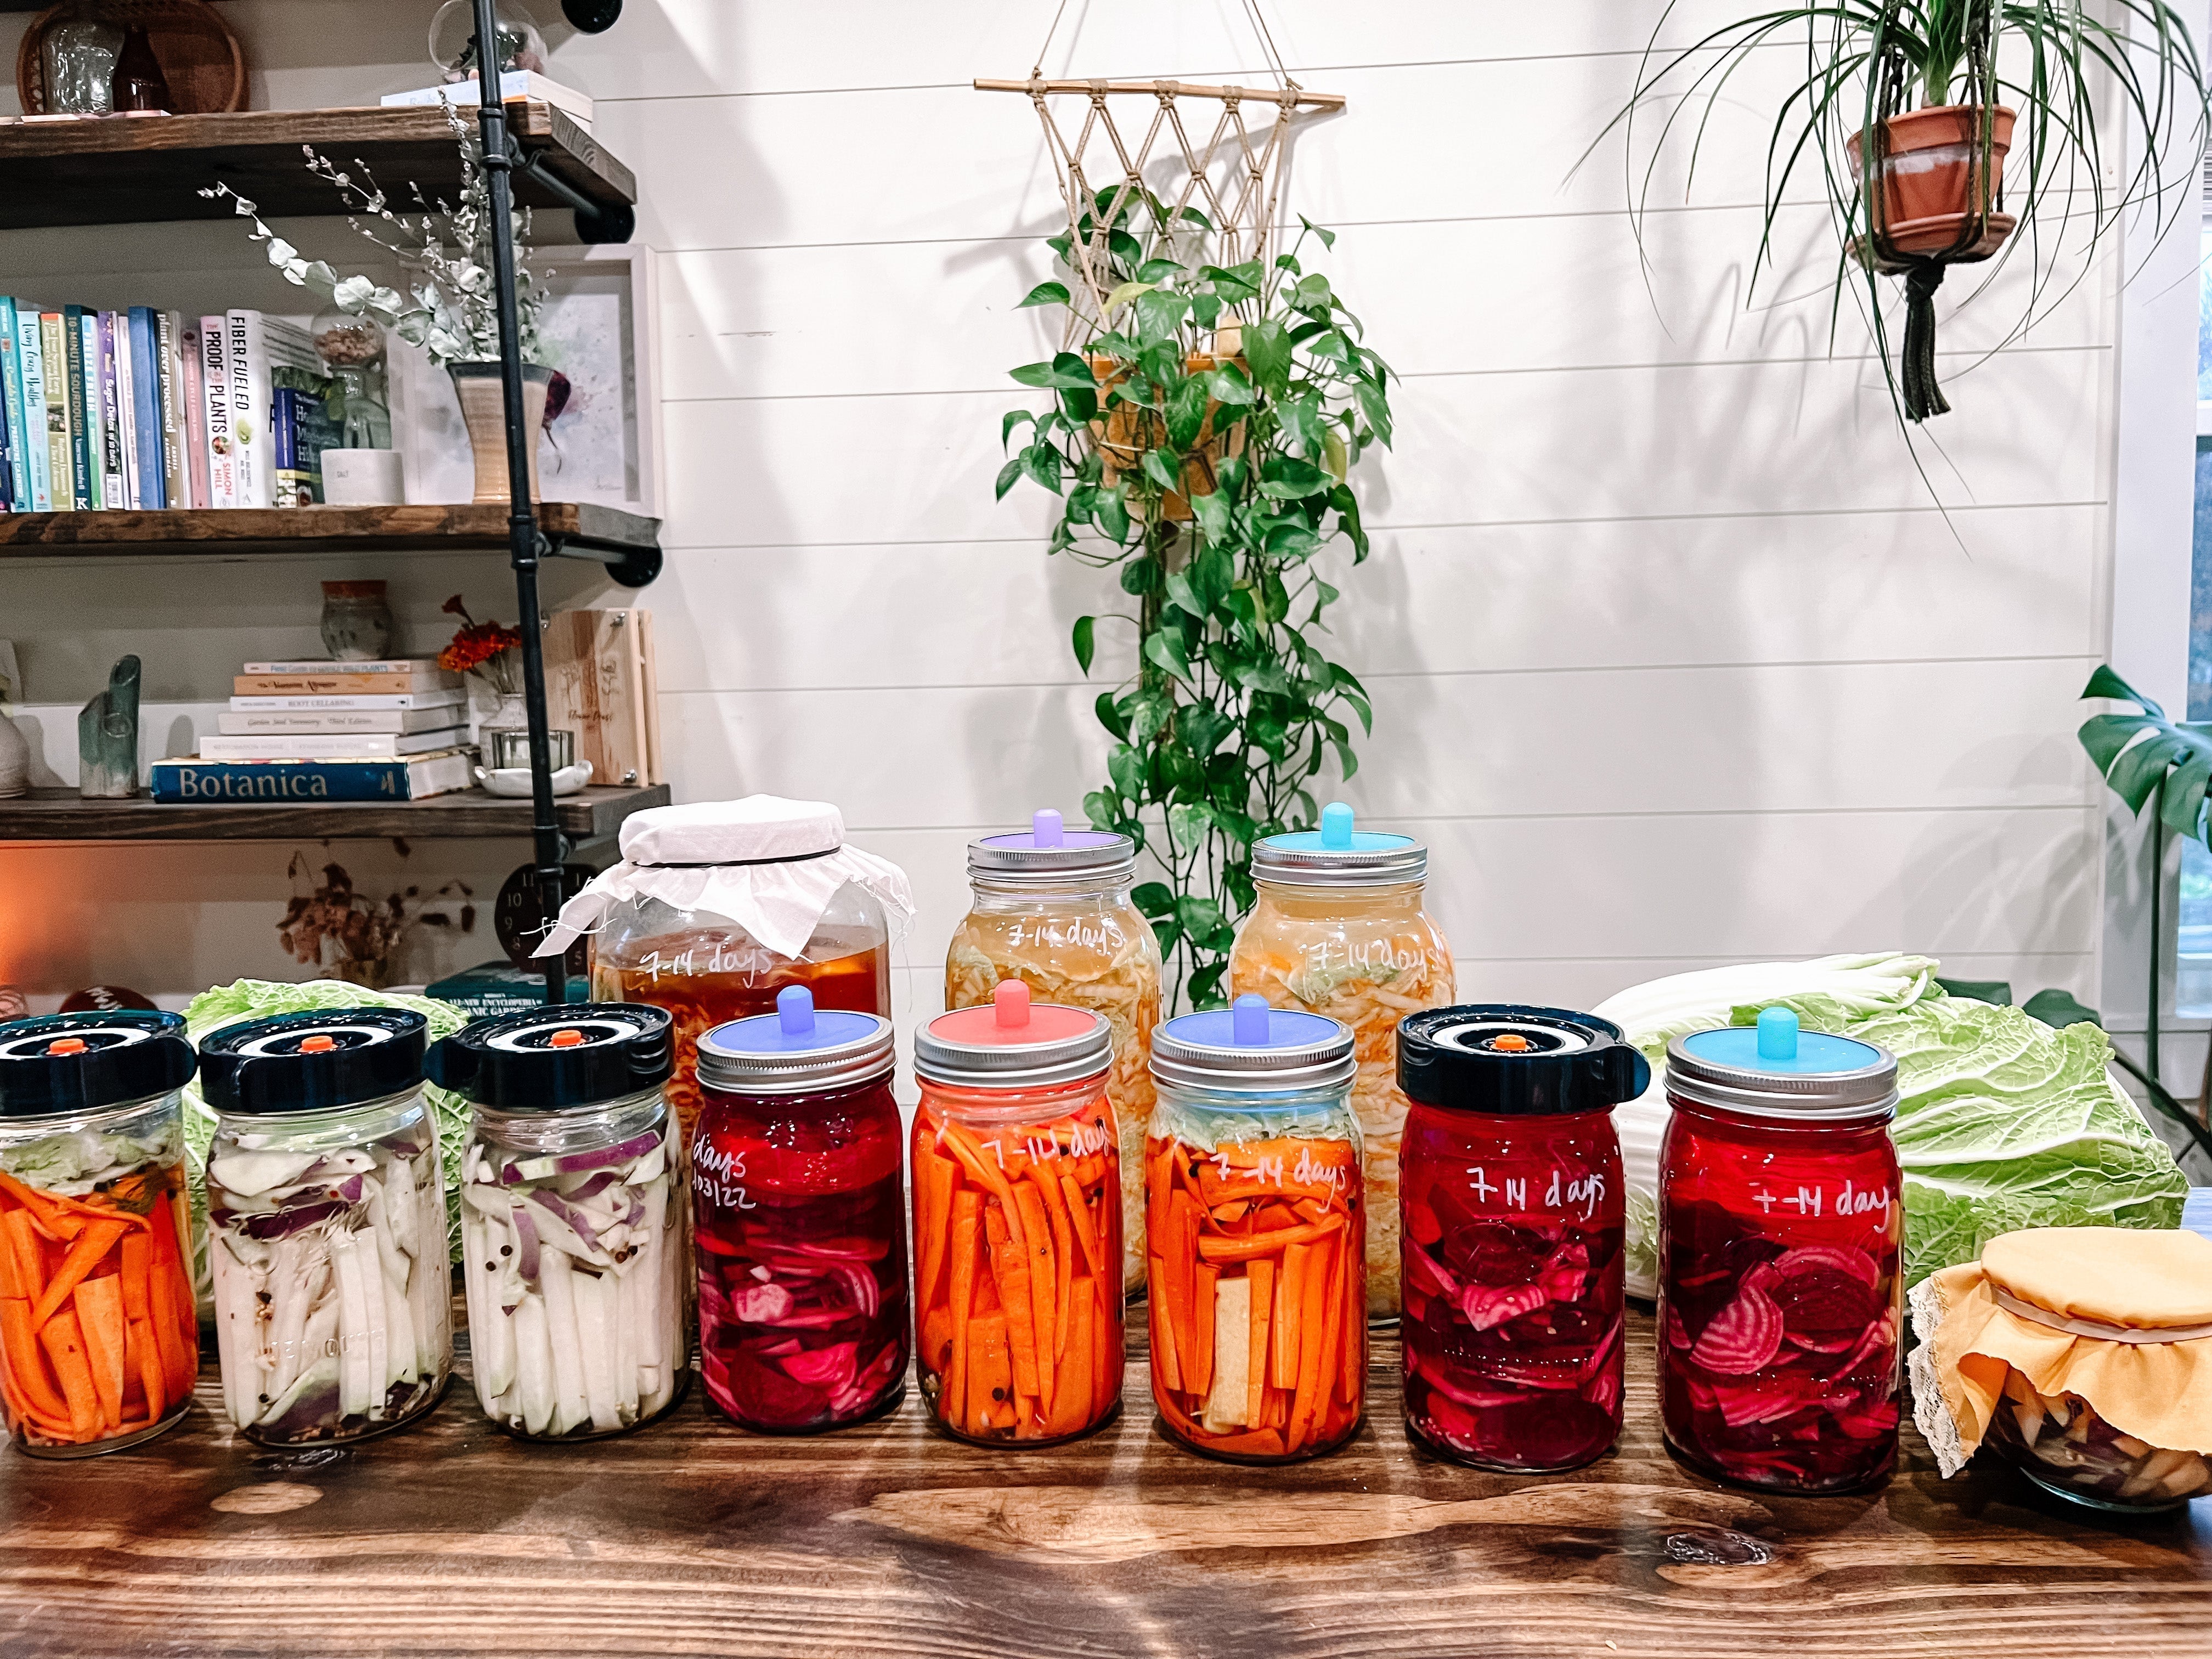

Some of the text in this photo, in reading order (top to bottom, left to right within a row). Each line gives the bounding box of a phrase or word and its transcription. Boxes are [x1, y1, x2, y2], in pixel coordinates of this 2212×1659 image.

[21, 323, 36, 347] Living
[206, 331, 223, 371] PROOF
[67, 317, 82, 436] 10-MINUTE SOURDOUGH
[84, 332, 97, 411] FREEZE FRESH
[157, 314, 176, 433] plant over processed
[231, 317, 249, 410] FIBER FUELED
[104, 379, 114, 404] Sugar
[210, 385, 227, 433] PLANTS
[107, 406, 115, 430] Detox
[213, 469, 222, 489] HILL
[223, 462, 233, 496] SIMON
[179, 769, 327, 797] Botanica
[508, 892, 521, 907] 10
[505, 916, 512, 930] 9
[512, 936, 521, 950] 8
[1066, 916, 1124, 957] days
[575, 950, 582, 966] 5
[708, 942, 772, 989] days
[1380, 938, 1441, 983] days
[693, 1133, 746, 1184] days
[1294, 1147, 1346, 1214] days
[1545, 1170, 1606, 1223] days
